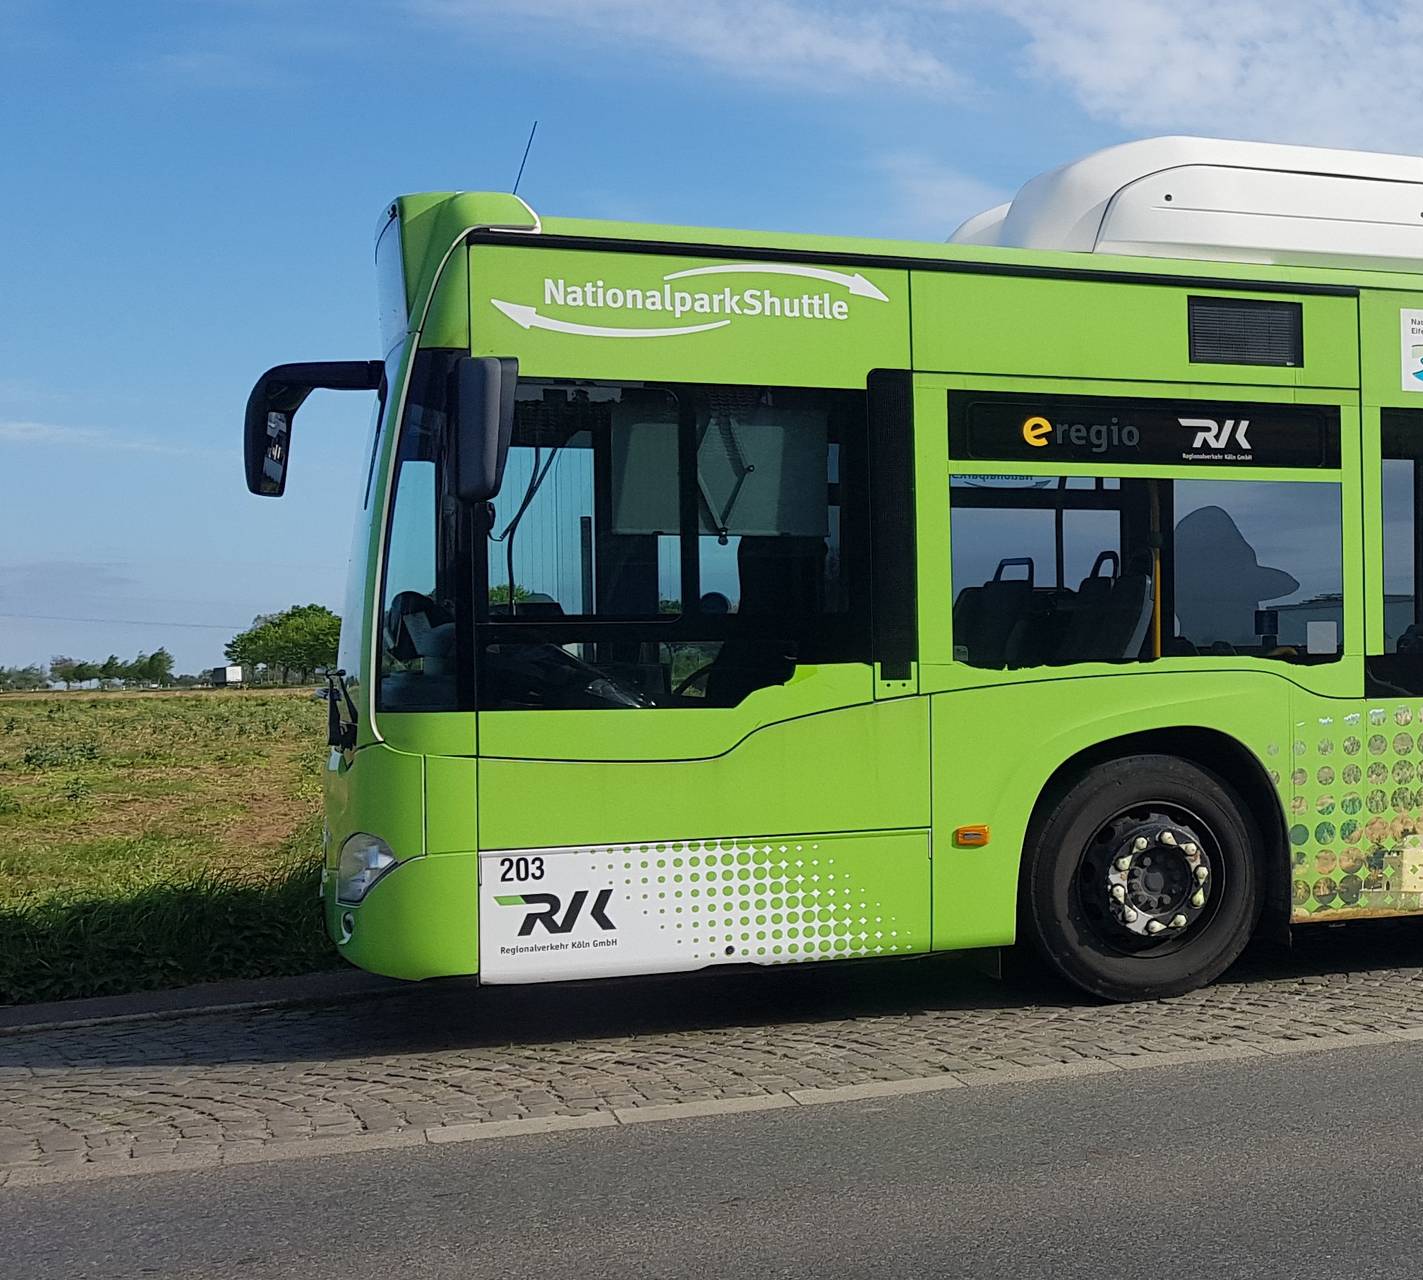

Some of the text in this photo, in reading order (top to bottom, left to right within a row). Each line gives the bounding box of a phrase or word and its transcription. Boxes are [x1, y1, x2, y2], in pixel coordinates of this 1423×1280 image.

[543, 277, 850, 320] NationalparkShuttle
[499, 856, 546, 883] 203
[500, 938, 618, 956] Regionalverkehr Köln GmbH
